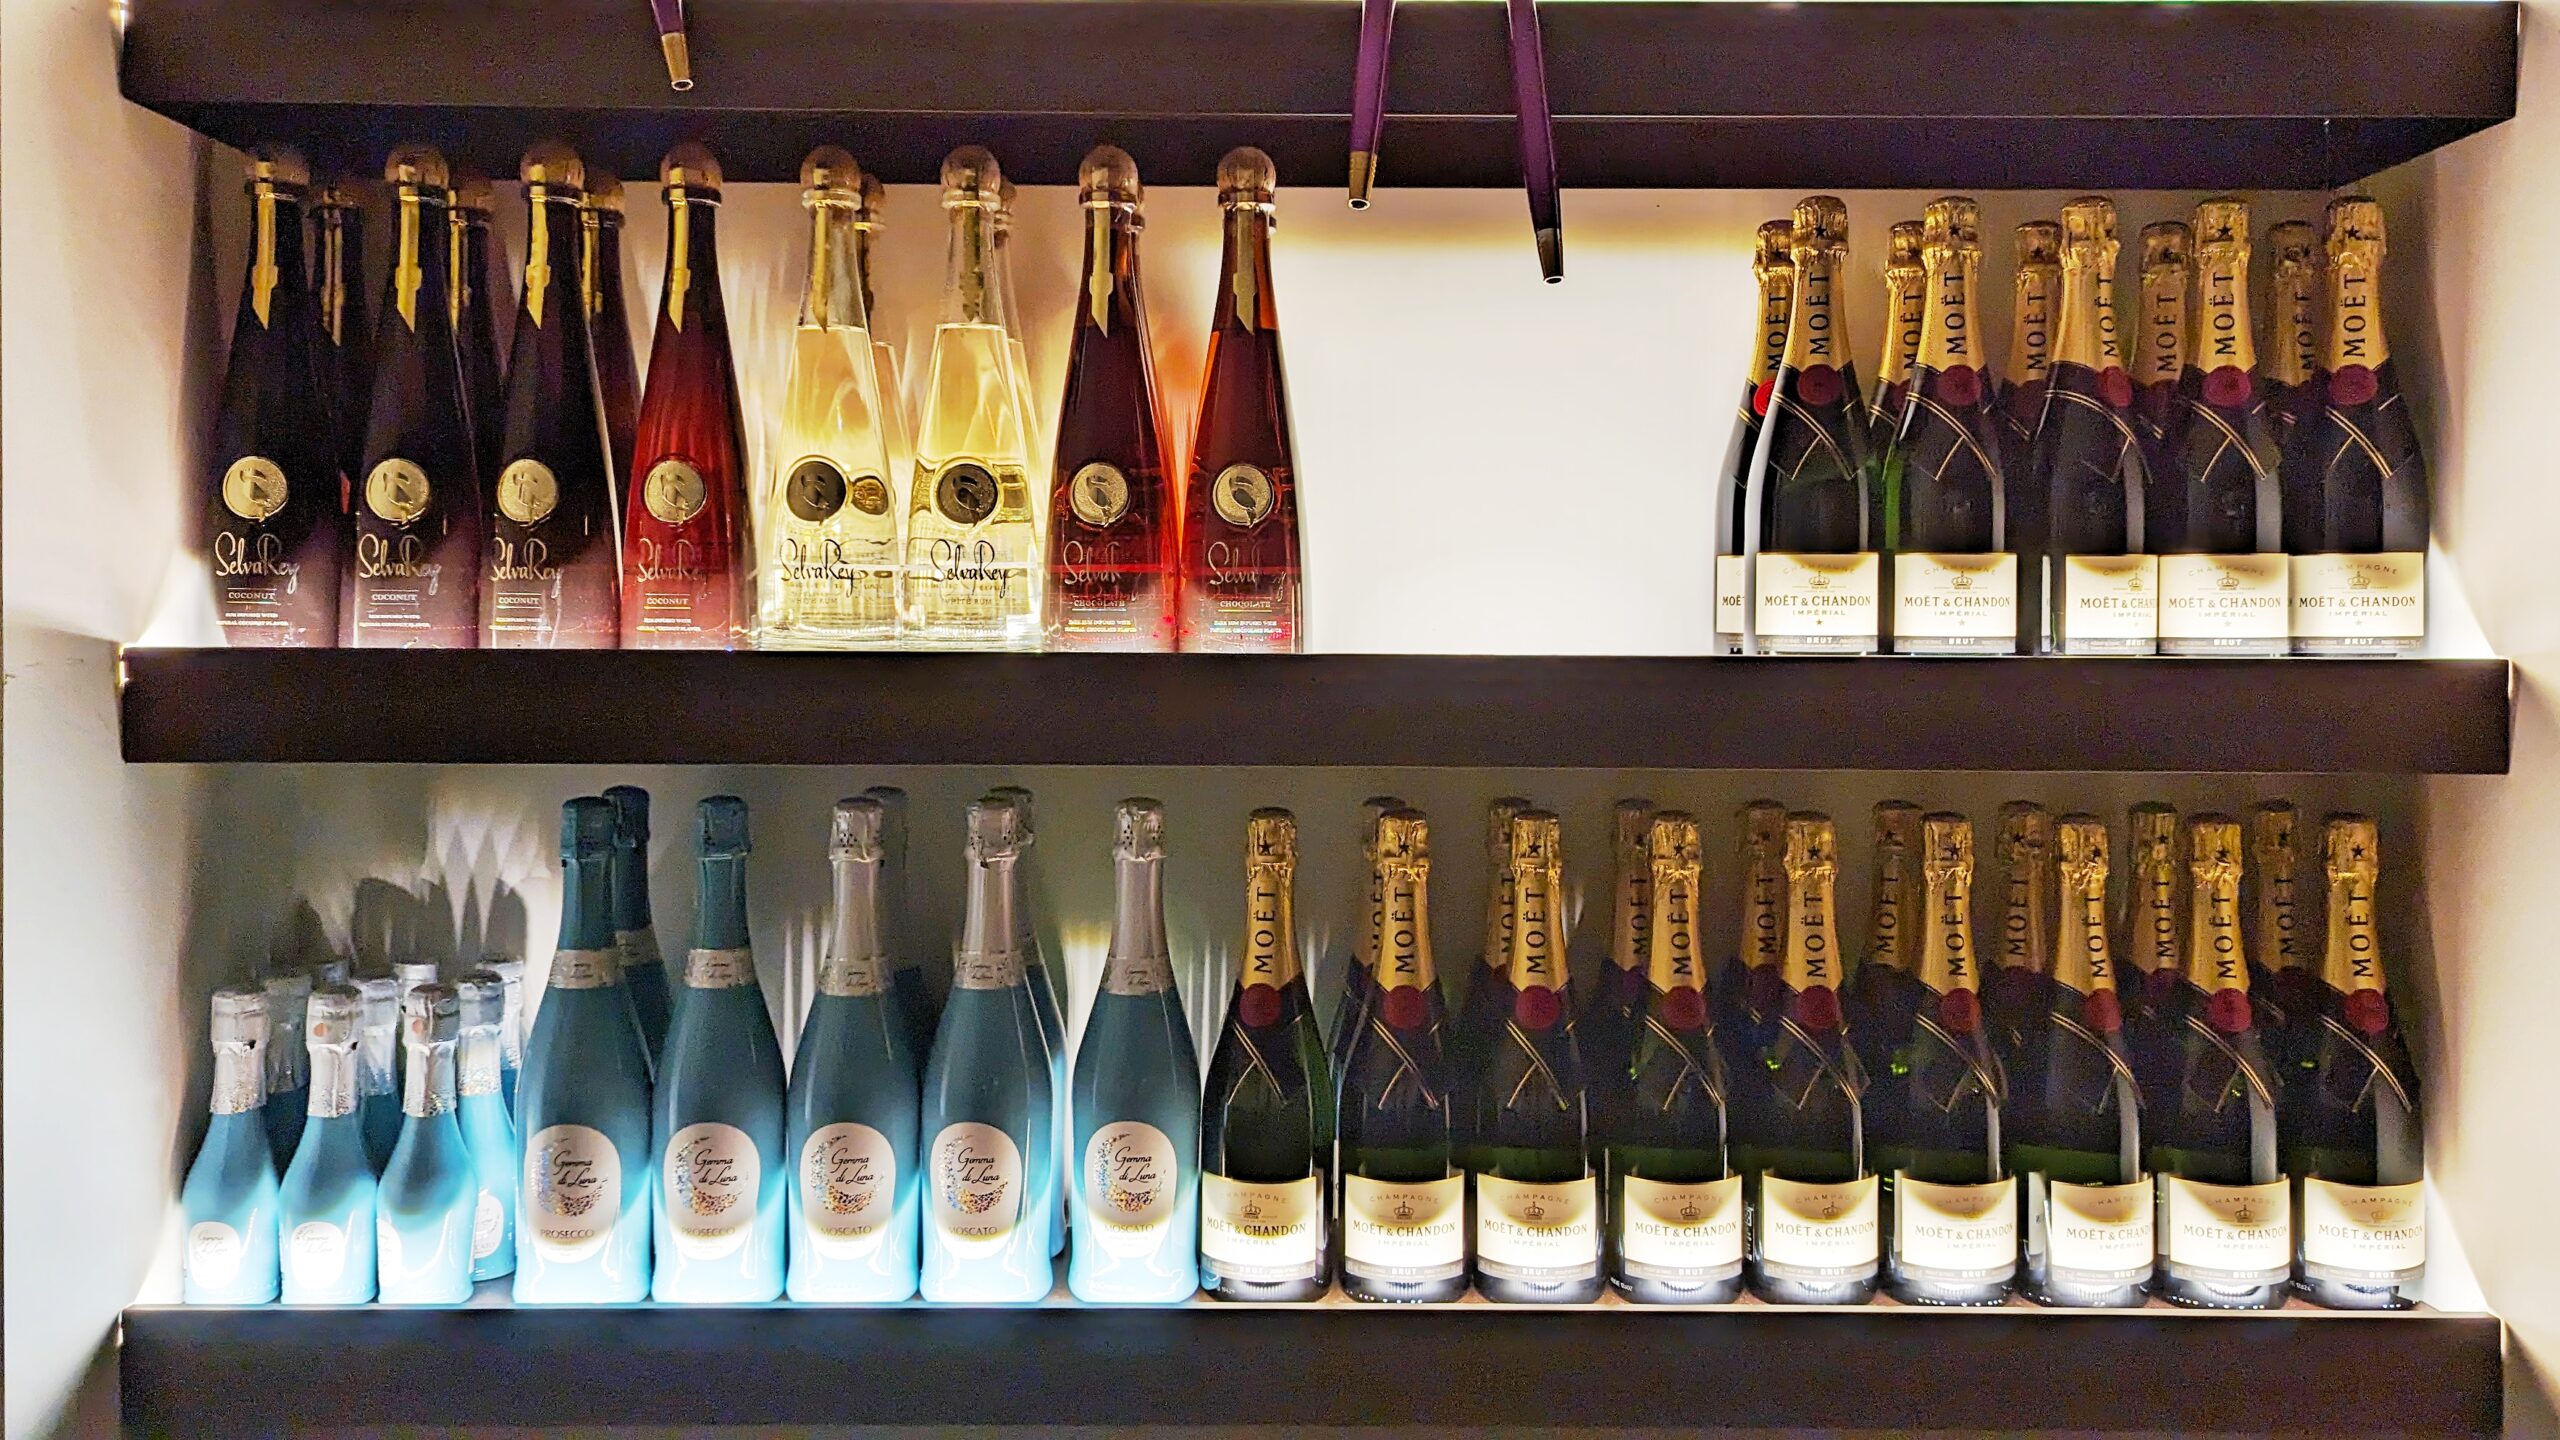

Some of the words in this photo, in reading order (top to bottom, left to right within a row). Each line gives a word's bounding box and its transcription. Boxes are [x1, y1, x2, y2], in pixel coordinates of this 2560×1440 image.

[1805, 272, 1830, 355] MOËT
[1941, 271, 1967, 354] MOËT
[2093, 275, 2119, 357] MOËT
[2208, 271, 2236, 355] MOËT
[2340, 273, 2367, 357] MOËT
[1767, 292, 1788, 370] MOËT
[2022, 291, 2047, 370] MOËT
[2152, 294, 2178, 372] MOËT
[214, 531, 300, 595] SelvaRey
[359, 533, 442, 596] SelvaRey
[780, 538, 854, 598] SelvaRey
[930, 538, 1007, 599] SelvaRey
[228, 592, 276, 600] COCONUT
[371, 593, 418, 601] COCONUT
[498, 597, 540, 605] COCONUT
[646, 597, 689, 605] COCONUT
[1220, 601, 1271, 609] CHOCOLATE
[1722, 595, 1745, 607] MOË
[1764, 595, 1799, 607] MOËT
[1801, 598, 1809, 607] &
[1812, 595, 1871, 607] CHANDON
[1904, 595, 1940, 608] MOËT
[1943, 598, 1951, 608] &
[1954, 596, 2010, 608] CHANDON
[2080, 596, 2119, 609] MOËT
[2121, 599, 2128, 609] &
[2168, 597, 2205, 609] MOËT
[2208, 599, 2216, 609] &
[2219, 597, 2281, 609] CHANDON
[2299, 596, 2336, 608] MOËT
[2338, 598, 2346, 608] &
[2350, 596, 2416, 608] CHANDON
[1792, 608, 1846, 616] IMPÉRIAL
[1755, 874, 1777, 954] MOËT
[2151, 879, 2175, 957] MOËT
[1253, 887, 1276, 974] MOËT
[1391, 887, 1415, 974] MOËT
[1522, 887, 1547, 974] MOËT
[1667, 889, 1693, 976] MOËT
[1800, 891, 1827, 978] MOËT
[1940, 890, 1967, 977] MOËT
[2083, 896, 2108, 978] MOËT
[2208, 893, 2237, 979] MOËT
[2344, 893, 2374, 978] MOËT
[553, 1150, 593, 1175] Gemma
[693, 1149, 734, 1174] Gemma
[830, 1147, 870, 1173] Gemma
[957, 1147, 995, 1172] Gemma
[1114, 1146, 1152, 1171] Gemma
[568, 1167, 598, 1187] Luna
[699, 1170, 708, 1183] di
[709, 1166, 738, 1186] Luna
[836, 1169, 845, 1182] di
[846, 1164, 874, 1185] Luna
[962, 1169, 971, 1182] di
[971, 1164, 1000, 1185] Luna
[1119, 1168, 1128, 1181] di
[1128, 1162, 1156, 1183] Luna
[540, 1228, 595, 1239] PROSECCO
[1207, 1216, 1233, 1232] MOËT
[1235, 1225, 1241, 1234] &
[1244, 1223, 1307, 1237] CHANDON
[1353, 1220, 1384, 1235] MOËT
[1386, 1228, 1393, 1237] &
[1396, 1222, 1457, 1238] CHANDON
[1484, 1218, 1514, 1234] MOËT
[1517, 1227, 1523, 1237] &
[1526, 1223, 1588, 1238] CHANDON
[1635, 1221, 1669, 1237] MOËT
[1672, 1228, 1681, 1238] &
[1683, 1221, 1737, 1238] CHANDON
[1775, 1222, 1812, 1237] MOËT
[1814, 1229, 1822, 1238] &
[1915, 1225, 1953, 1239] MOËT
[1956, 1231, 1964, 1240] &
[2066, 1227, 2106, 1240] MOËT
[2109, 1231, 2116, 1240] &
[2184, 1224, 2223, 1240] MOËT
[2226, 1231, 2234, 1241] &
[2318, 1224, 2359, 1240] MOËT
[2362, 1231, 2370, 1240] &
